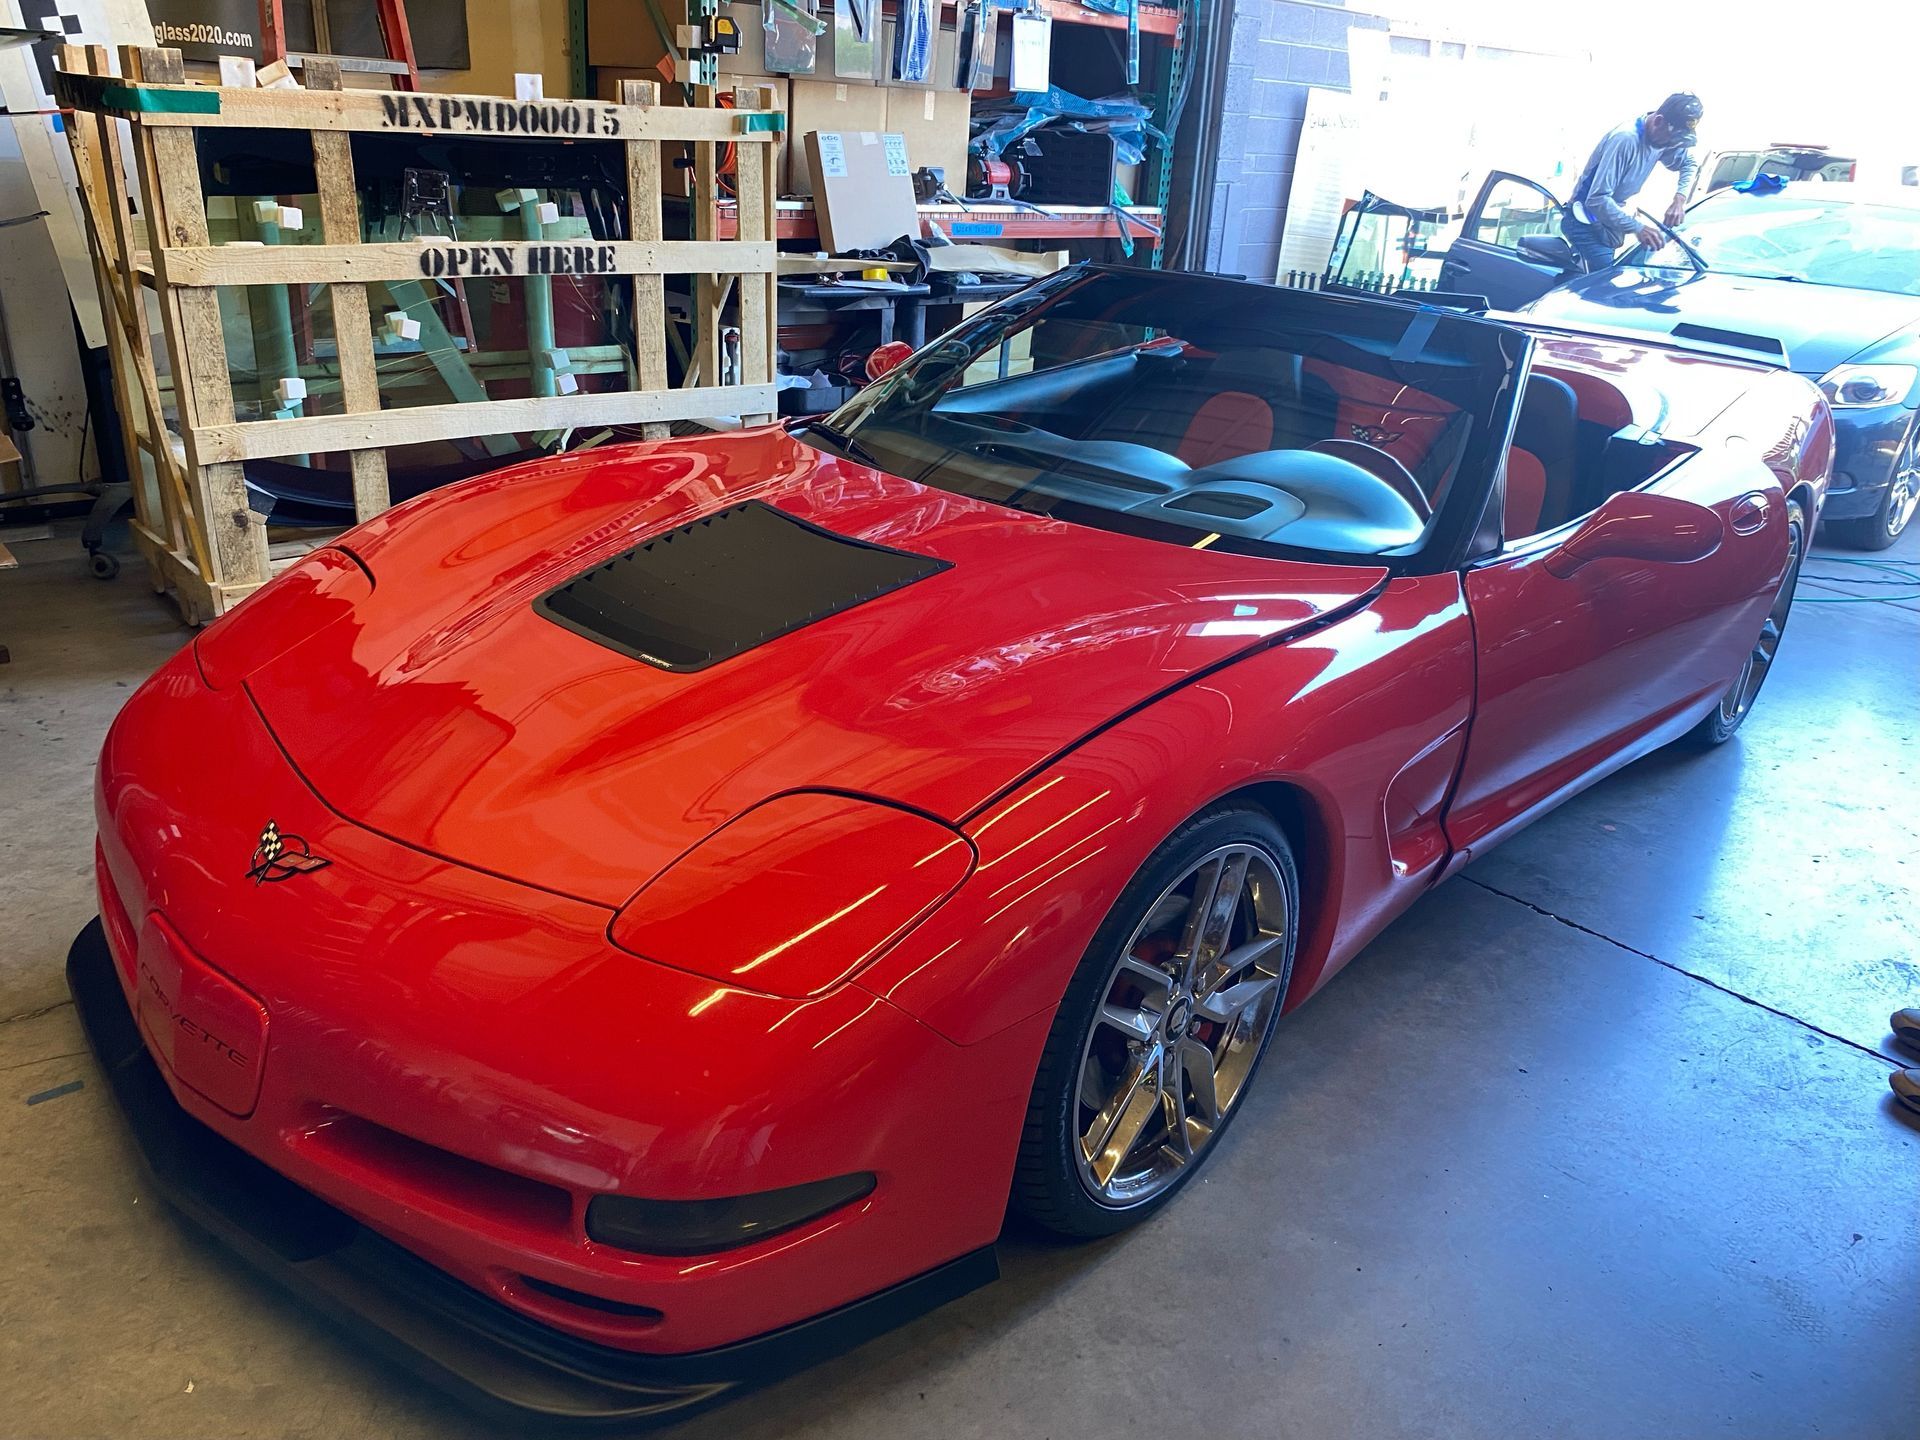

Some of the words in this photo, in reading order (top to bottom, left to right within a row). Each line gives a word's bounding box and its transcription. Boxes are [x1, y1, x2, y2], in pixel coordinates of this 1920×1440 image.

[382, 95, 620, 135] MXPMD00015
[420, 247, 515, 277] OPEN
[527, 245, 617, 275] HERE
[141, 961, 249, 1068] CORVETTE
